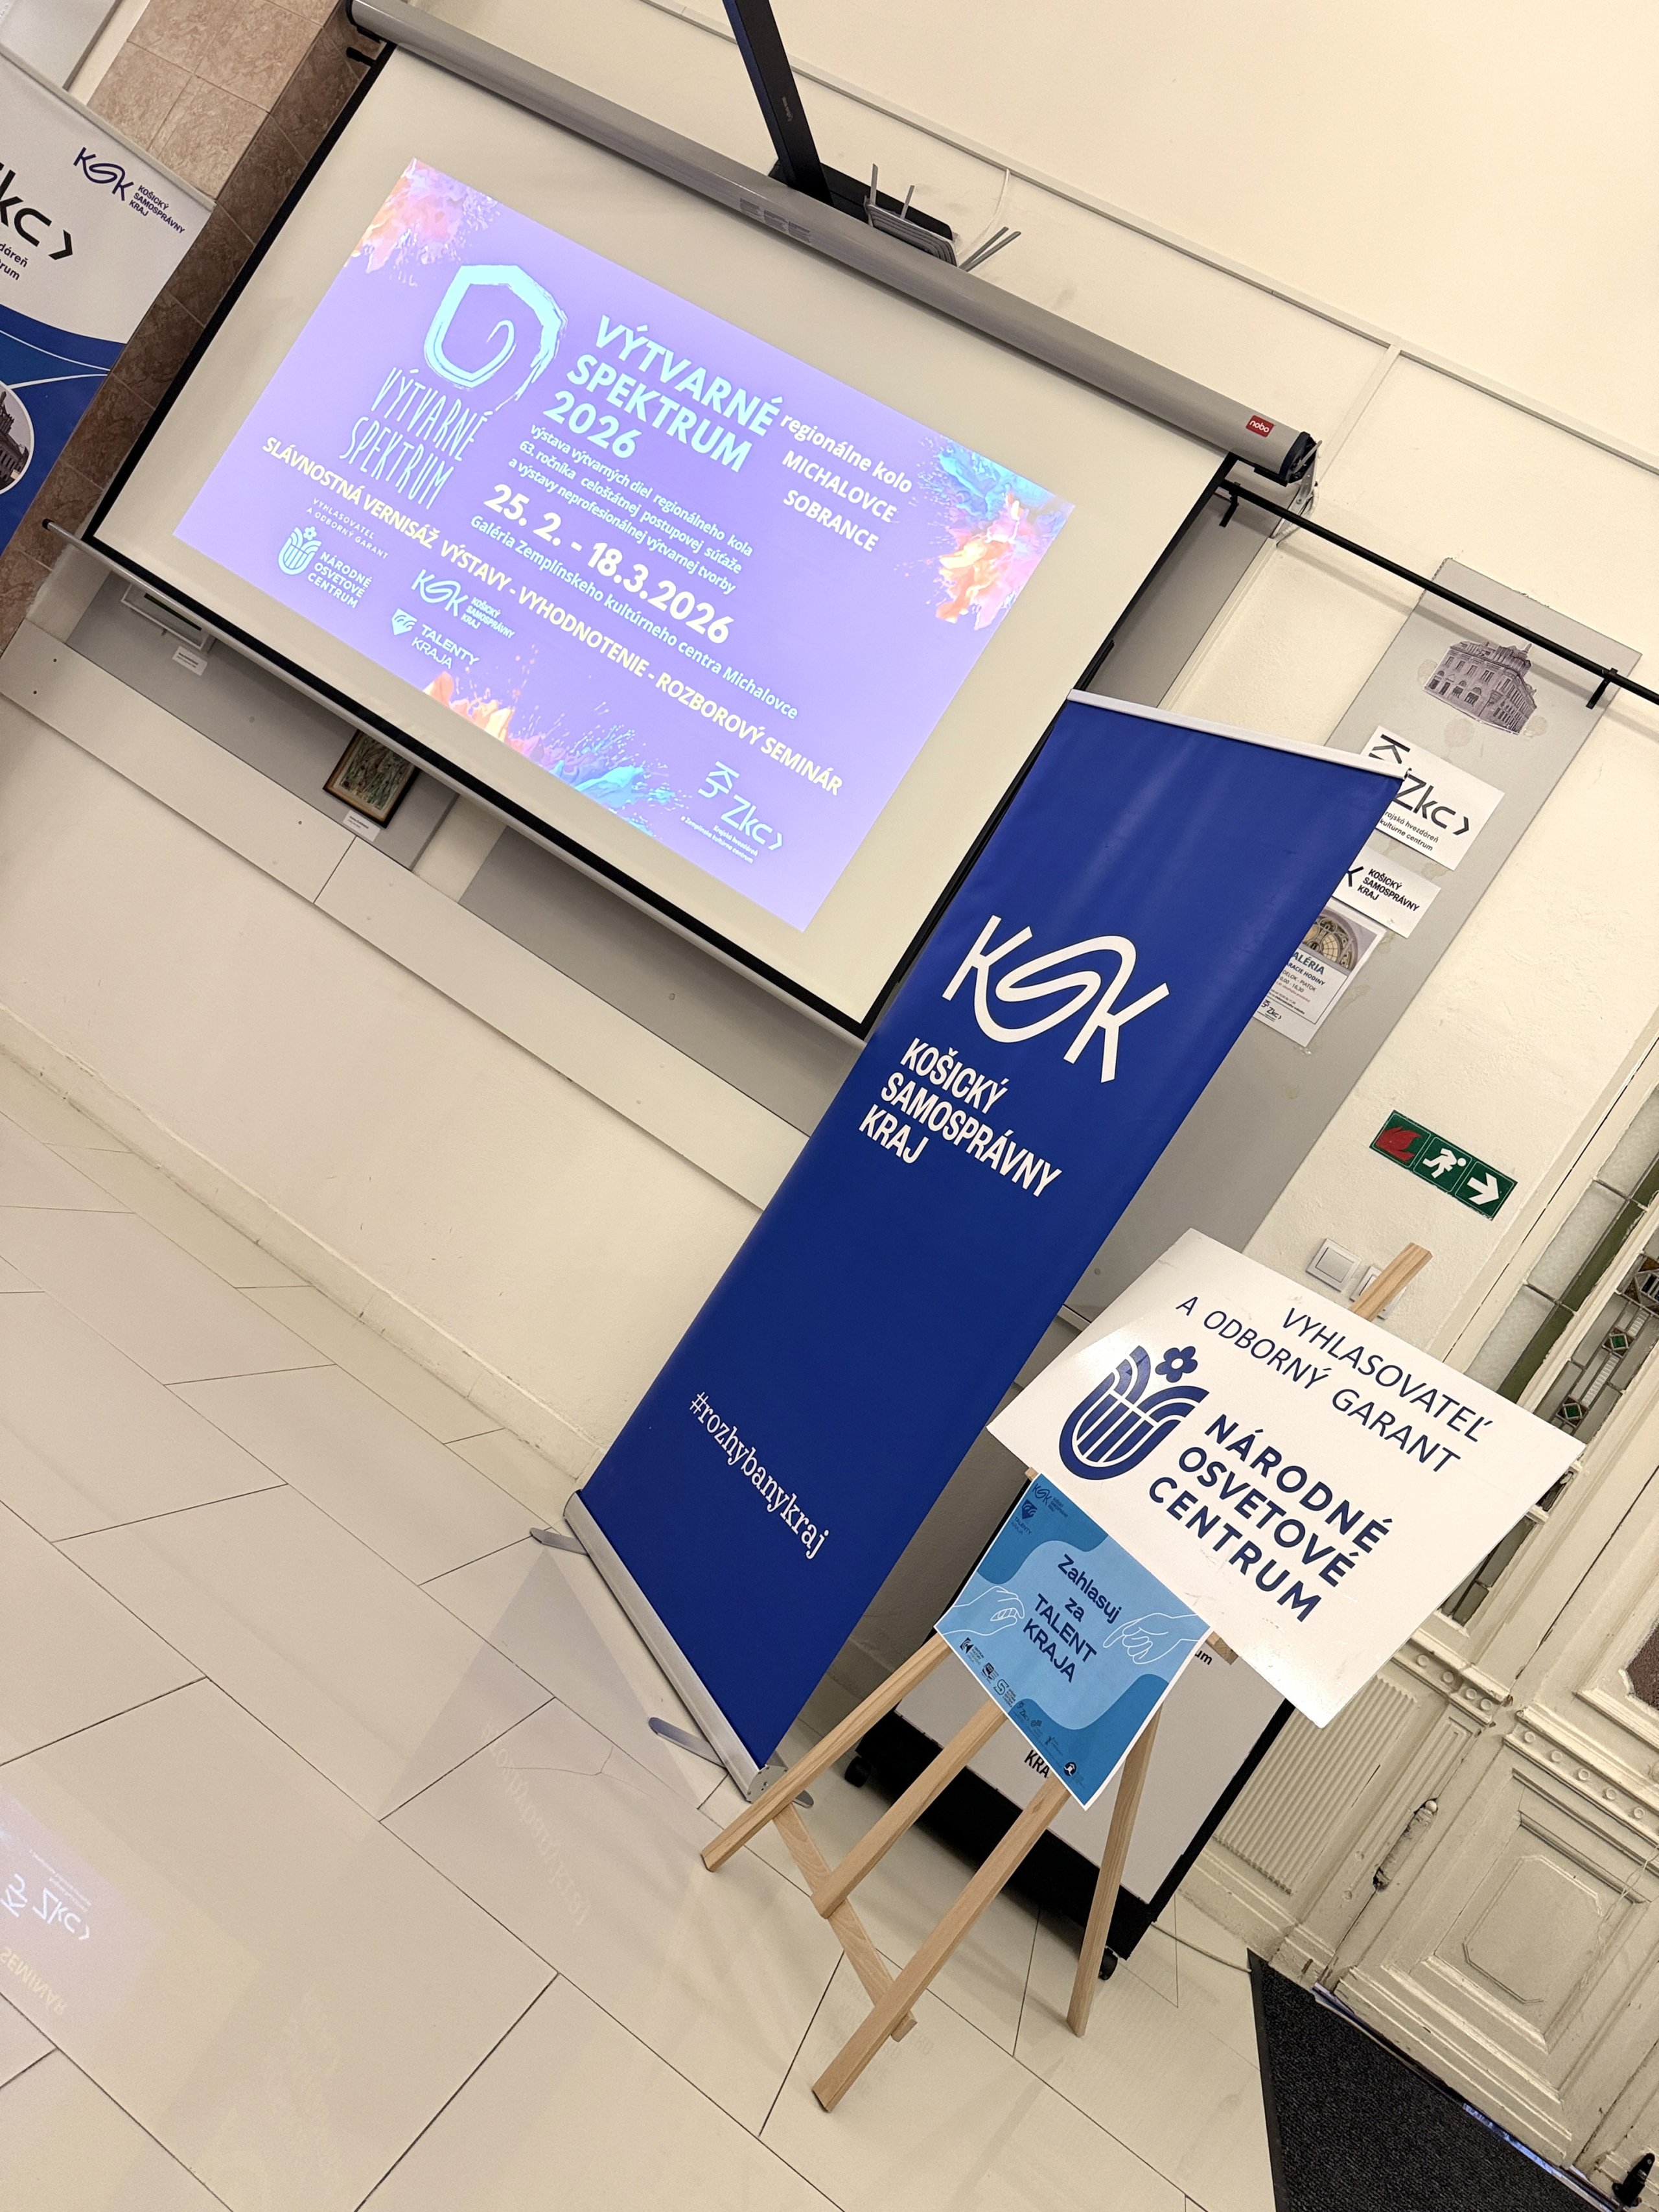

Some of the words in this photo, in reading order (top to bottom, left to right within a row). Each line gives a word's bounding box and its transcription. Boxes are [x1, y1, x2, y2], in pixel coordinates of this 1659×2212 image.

[129, 200, 149, 217] KRAJ
[133, 192, 185, 234] SAMOSPRÁVNY
[137, 185, 169, 211] KOŠICKÝ
[596, 314, 783, 437] VÝTVARNÉ
[371, 367, 493, 461] VÝTVARNÉ
[543, 391, 642, 458] 2026
[566, 354, 752, 472] SPEKTRUM
[1249, 420, 1270, 433] nobo
[339, 416, 454, 510] SPEKTRUM
[780, 415, 872, 472] regionálne
[872, 460, 912, 493] kolo
[519, 440, 535, 457] 63.
[535, 450, 577, 480] ročníka
[580, 476, 642, 518] celoštátnej
[639, 511, 704, 554] postupovej
[704, 547, 743, 574] súťaže
[530, 424, 572, 454] výstava
[571, 448, 631, 487] výtvarných
[629, 480, 653, 498] diel
[653, 494, 725, 541] regionálneho
[726, 534, 753, 557] kola
[782, 450, 898, 522] MICHALOVCE
[312, 497, 376, 540] VYHLASOVATEĽ
[314, 511, 354, 539] ODBORNÝ
[354, 535, 389, 560] GARANT
[508, 457, 518, 468] a
[517, 462, 559, 493] výstavy
[557, 486, 648, 544] neprofesionálnej
[646, 535, 701, 575] výtvarnej
[697, 565, 737, 595] tvorby
[783, 490, 879, 552] SOBRANCE
[307, 572, 358, 609] CENTRUM
[314, 562, 365, 599] OSVETOVÉ
[319, 552, 373, 588] NÁRODNÉ
[483, 483, 530, 527] 25.
[533, 512, 562, 546] 2.
[571, 541, 583, 552] -
[587, 542, 735, 644] 18.3.2026
[262, 436, 366, 506] SLÁVNOSTNÁ
[362, 493, 441, 550] VERNISÁŽ
[440, 539, 513, 592] VÝSTAVY
[519, 585, 651, 679] VYHODNOTENIE
[655, 671, 765, 746] ROZBOROVÝ
[760, 736, 843, 797] SEMINÁR
[460, 613, 481, 629] KRAJ
[465, 605, 515, 638] SAMOSPRÁVNY
[470, 596, 501, 619] KOŠICKÝ
[470, 515, 516, 548] Galéria
[515, 539, 604, 602] Zemplínskeho
[603, 593, 678, 647] kultúrneho
[677, 641, 723, 675] centra
[722, 666, 798, 720] Michalovce
[411, 636, 452, 669] KRAJA
[421, 623, 480, 666] TALENTY
[1379, 818, 1406, 836] kultúrne
[1406, 833, 1433, 852] centrum
[1404, 821, 1439, 843] hvezdáreň
[1357, 885, 1380, 901] KRAJ
[1362, 877, 1420, 912] SAMOSPRÁVNY
[1368, 868, 1402, 891] KOŠICKÝ
[1286, 962, 1303, 974] RACIE
[1304, 971, 1326, 986] HODINY
[899, 1037, 1009, 1114] KOŠICKÝ
[859, 1104, 929, 1164] KRAJ
[881, 1072, 1062, 1198] SAMOSPRÁVNY
[1176, 1296, 1199, 1317] A
[1203, 1310, 1329, 1390] ODBORNÝ
[1331, 1388, 1461, 1473] GARANT
[1282, 1307, 1493, 1443] VYHLASOVATEĽ
[690, 1391, 830, 1560] #rozhybanykraj
[1204, 1414, 1393, 1554] NÁRODNÉ
[1178, 1446, 1360, 1588] OSVETOVÉ
[1148, 1476, 1322, 1624] CENTRUM
[1058, 1554, 1122, 1624] Zahlasuj
[1064, 1597, 1085, 1623] za
[1023, 1618, 1076, 1683] KRAJA
[1034, 1593, 1097, 1662] TALENT
[1024, 1749, 1050, 1778] KRA
